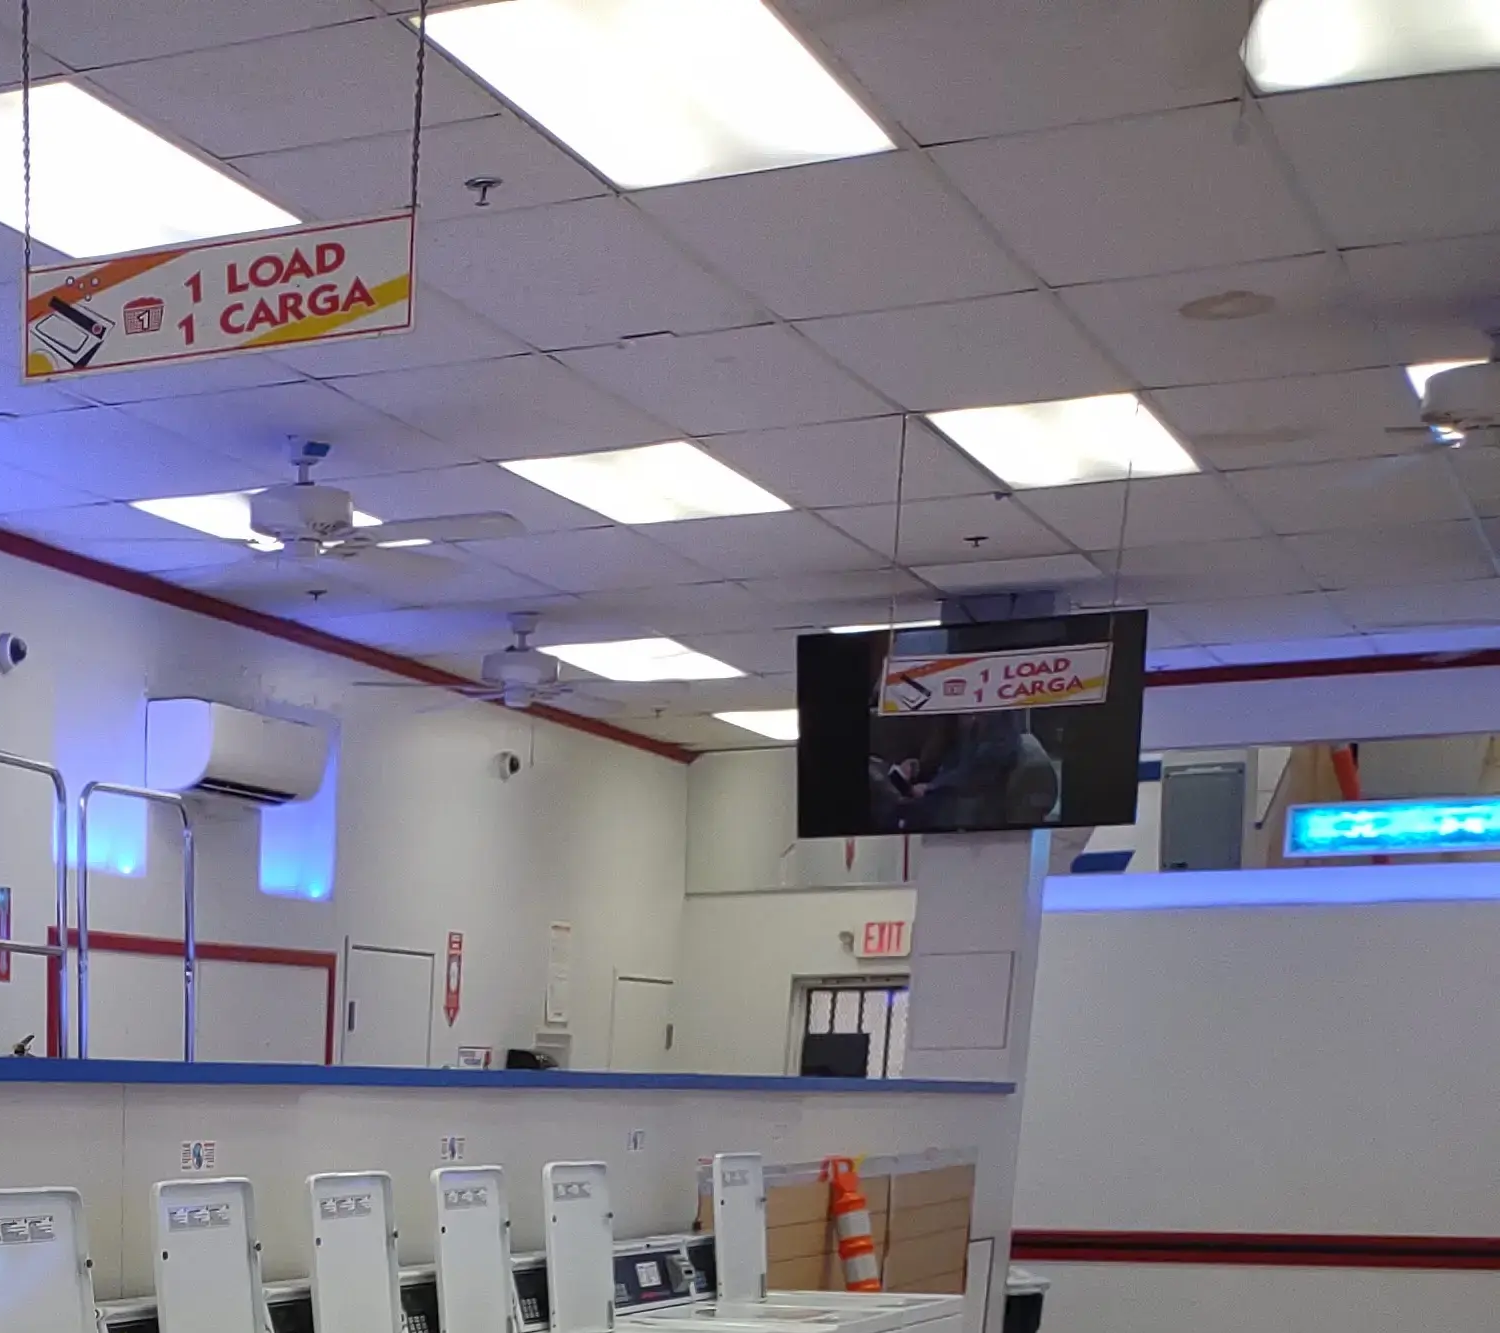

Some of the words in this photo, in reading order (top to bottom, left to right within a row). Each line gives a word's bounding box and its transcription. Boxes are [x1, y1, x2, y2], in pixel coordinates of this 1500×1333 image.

[184, 270, 202, 304] 1
[226, 242, 346, 296] LOAD
[178, 313, 195, 346] 1
[219, 276, 377, 336] CARGA
[1003, 658, 1071, 680] LOAD
[997, 675, 1084, 699] CARGA
[863, 921, 906, 955] EXIT
